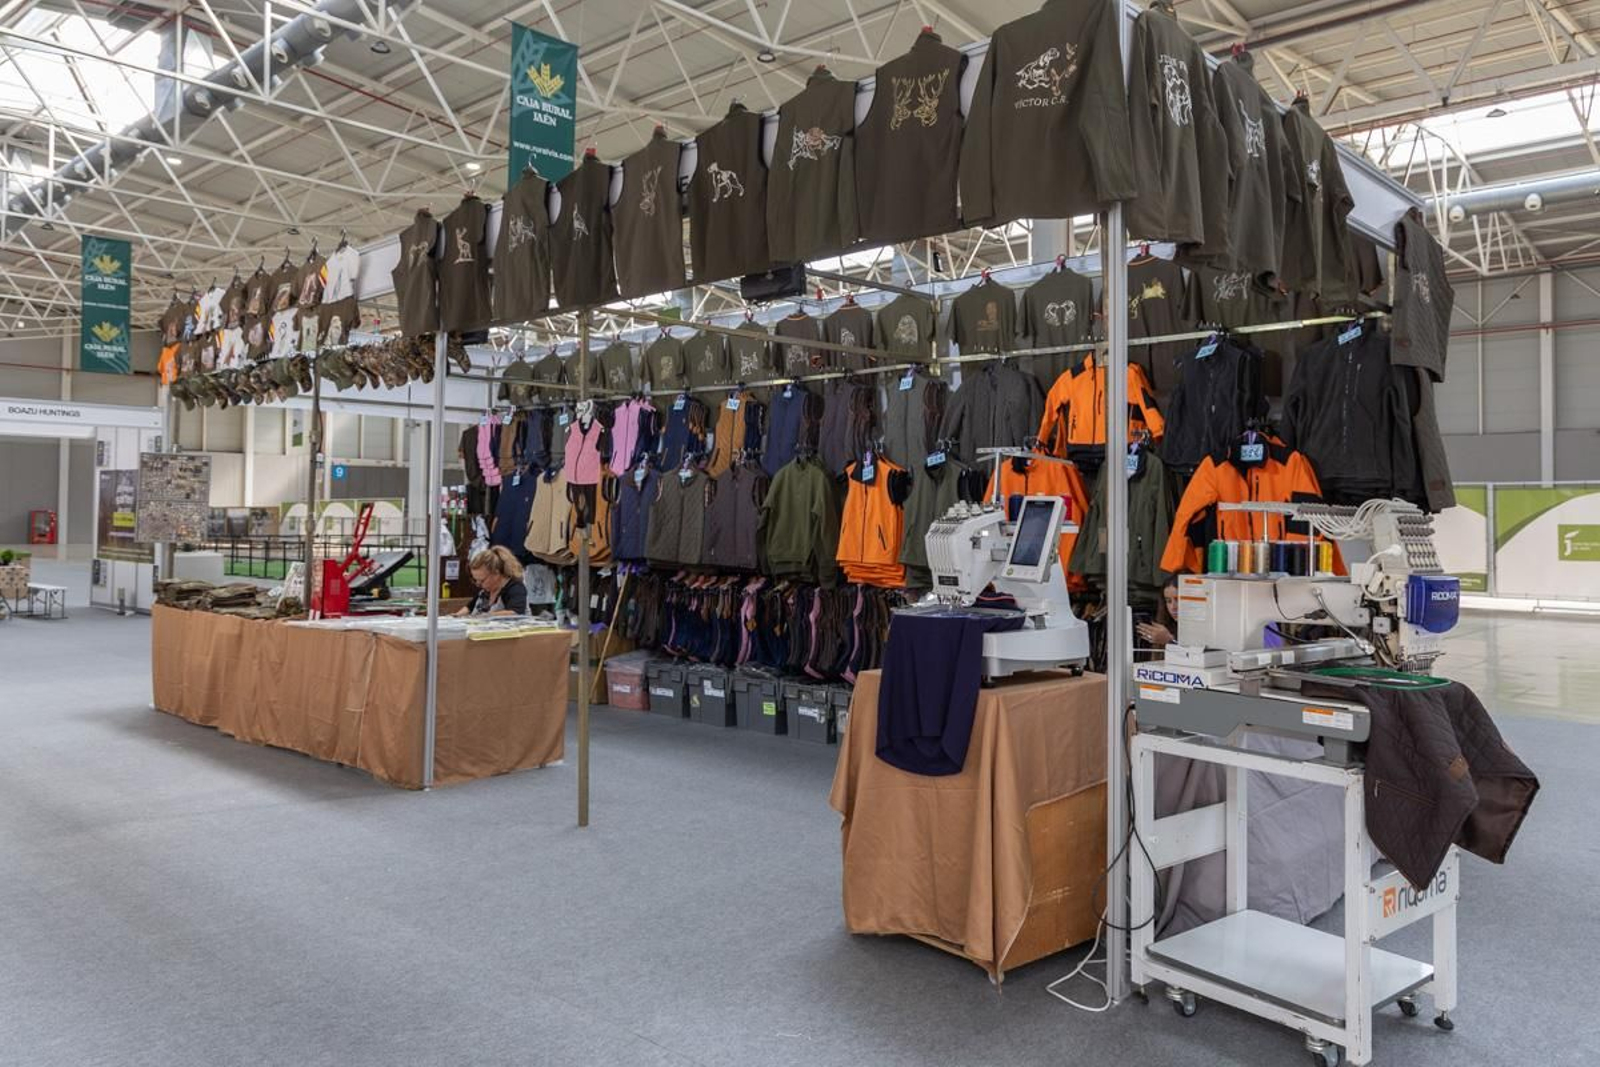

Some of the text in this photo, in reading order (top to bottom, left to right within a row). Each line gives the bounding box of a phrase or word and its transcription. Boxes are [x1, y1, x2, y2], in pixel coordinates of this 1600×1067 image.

[516, 95, 573, 120] CAJA RURAL
[334, 466, 344, 478] 9
